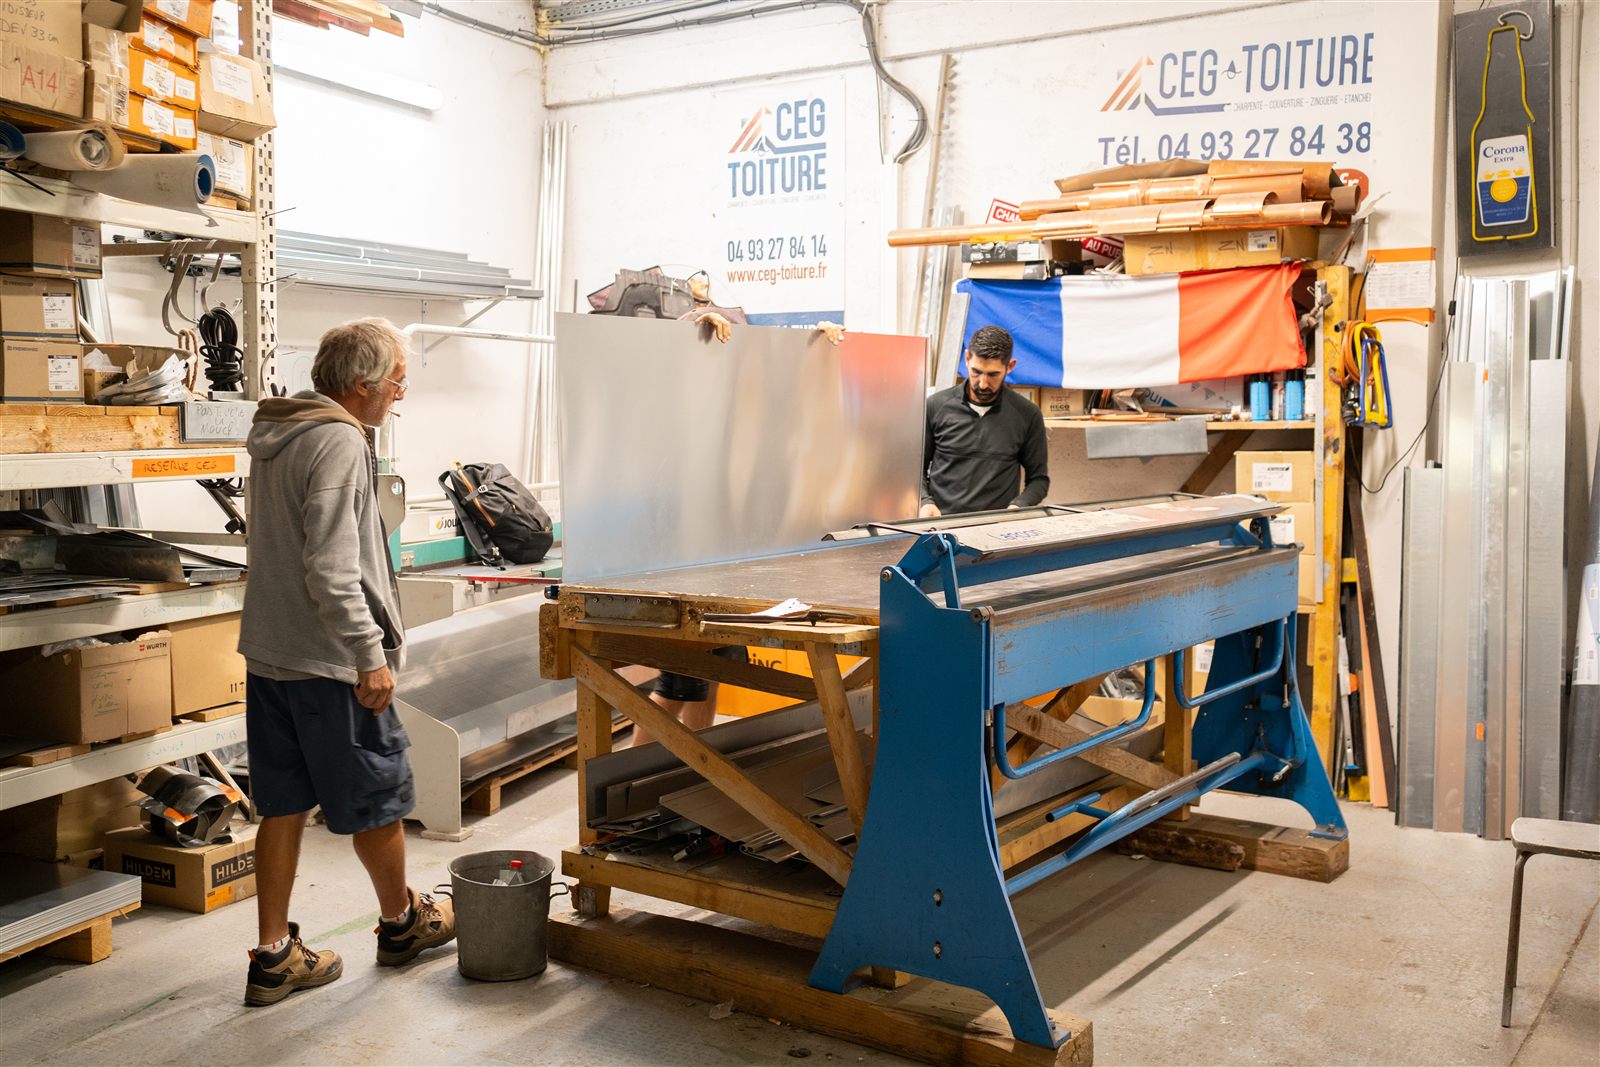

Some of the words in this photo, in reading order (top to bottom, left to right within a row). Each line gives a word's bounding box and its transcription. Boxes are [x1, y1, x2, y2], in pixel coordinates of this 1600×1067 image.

[31, 25, 45, 41] 33
[1158, 48, 1218, 99] CEG
[1242, 32, 1374, 93] TOITURE
[22, 65, 58, 94] A14
[776, 98, 826, 142] CEG
[1098, 135, 1147, 166] Tél.
[1158, 132, 1191, 161] 04
[1200, 129, 1234, 161] 93
[1243, 127, 1280, 159] 27
[1289, 124, 1326, 157] 84
[1336, 121, 1372, 154] 38
[1483, 144, 1526, 159] Corona
[727, 153, 827, 198] TOITURE
[995, 208, 1022, 224] CHAN
[727, 240, 744, 263] 04
[748, 238, 764, 261] 93
[768, 236, 784, 260] 27
[789, 235, 806, 260] 84
[811, 233, 828, 257] 14
[1085, 238, 1102, 252] AU
[1101, 243, 1121, 261] PUB
[726, 261, 828, 285] www.ceg-toiture.fr
[444, 518, 457, 528] JOU
[125, 860, 171, 881] HILDEM
[216, 855, 256, 880] HILDE
